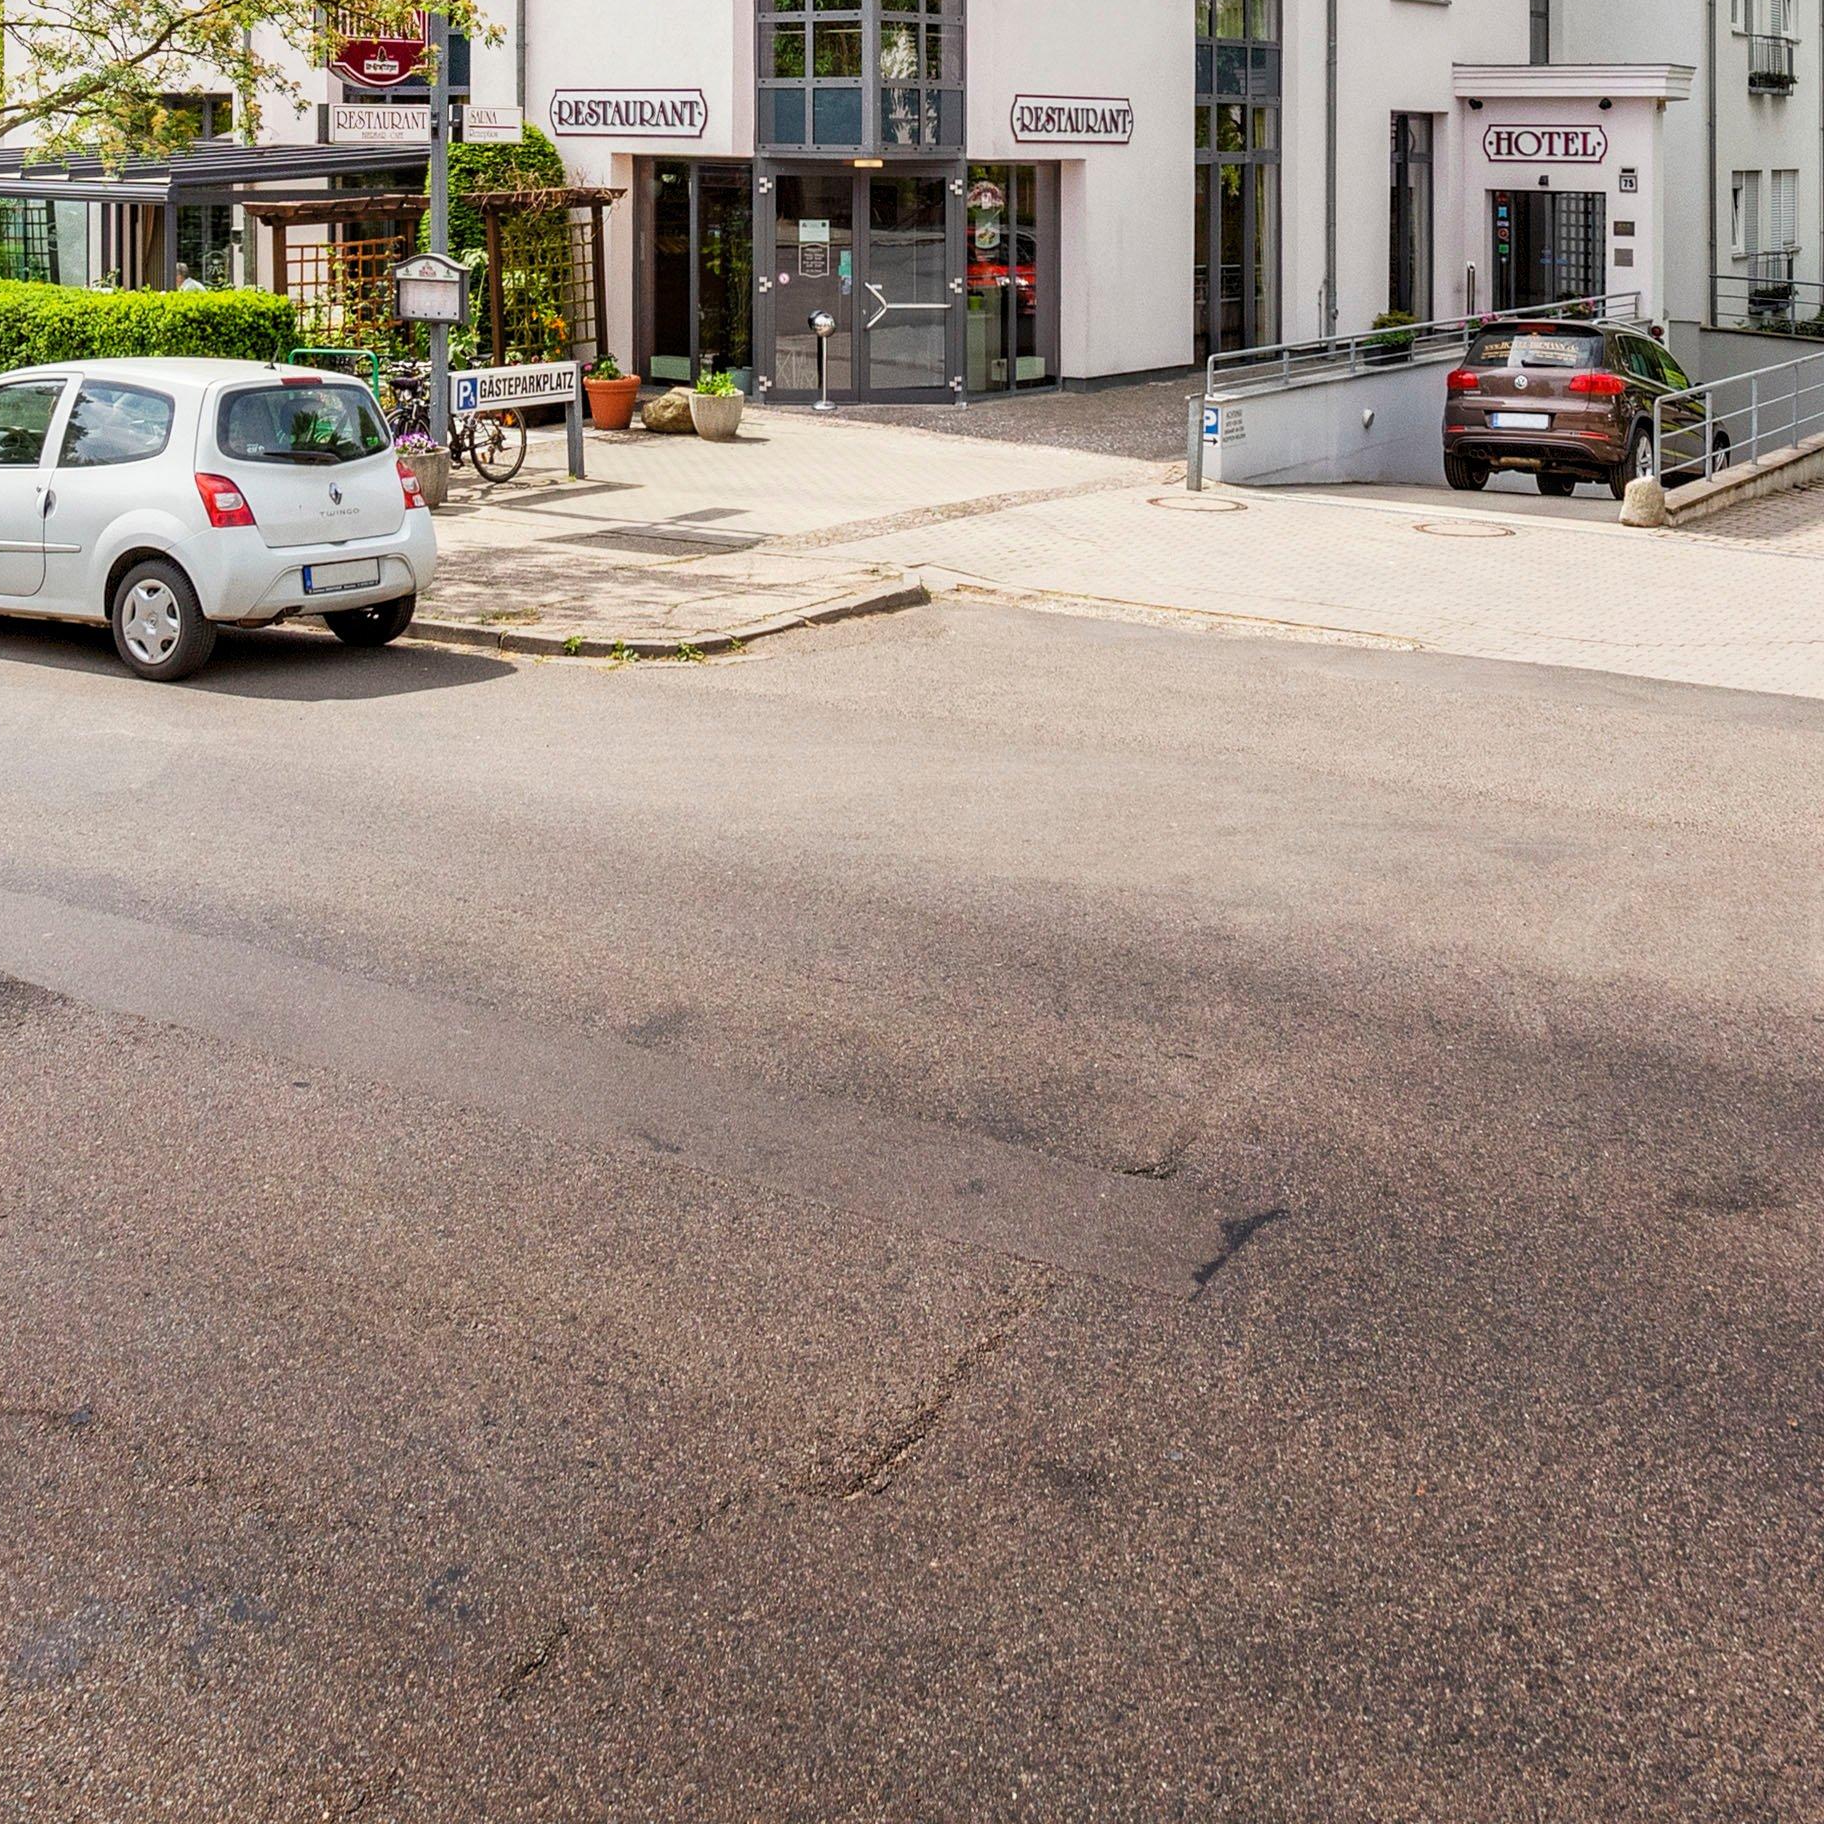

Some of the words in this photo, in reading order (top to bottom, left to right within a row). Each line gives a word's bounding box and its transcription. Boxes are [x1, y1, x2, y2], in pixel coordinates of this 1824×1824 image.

[336, 110, 427, 130] RESTAURANT
[556, 99, 701, 127] RESTAURANT
[1018, 106, 1129, 134] RESTAURANT
[1493, 131, 1596, 157] HOTEL
[479, 371, 574, 399] GÄSTEPARKPLATZ
[319, 507, 360, 517] TWINGO
